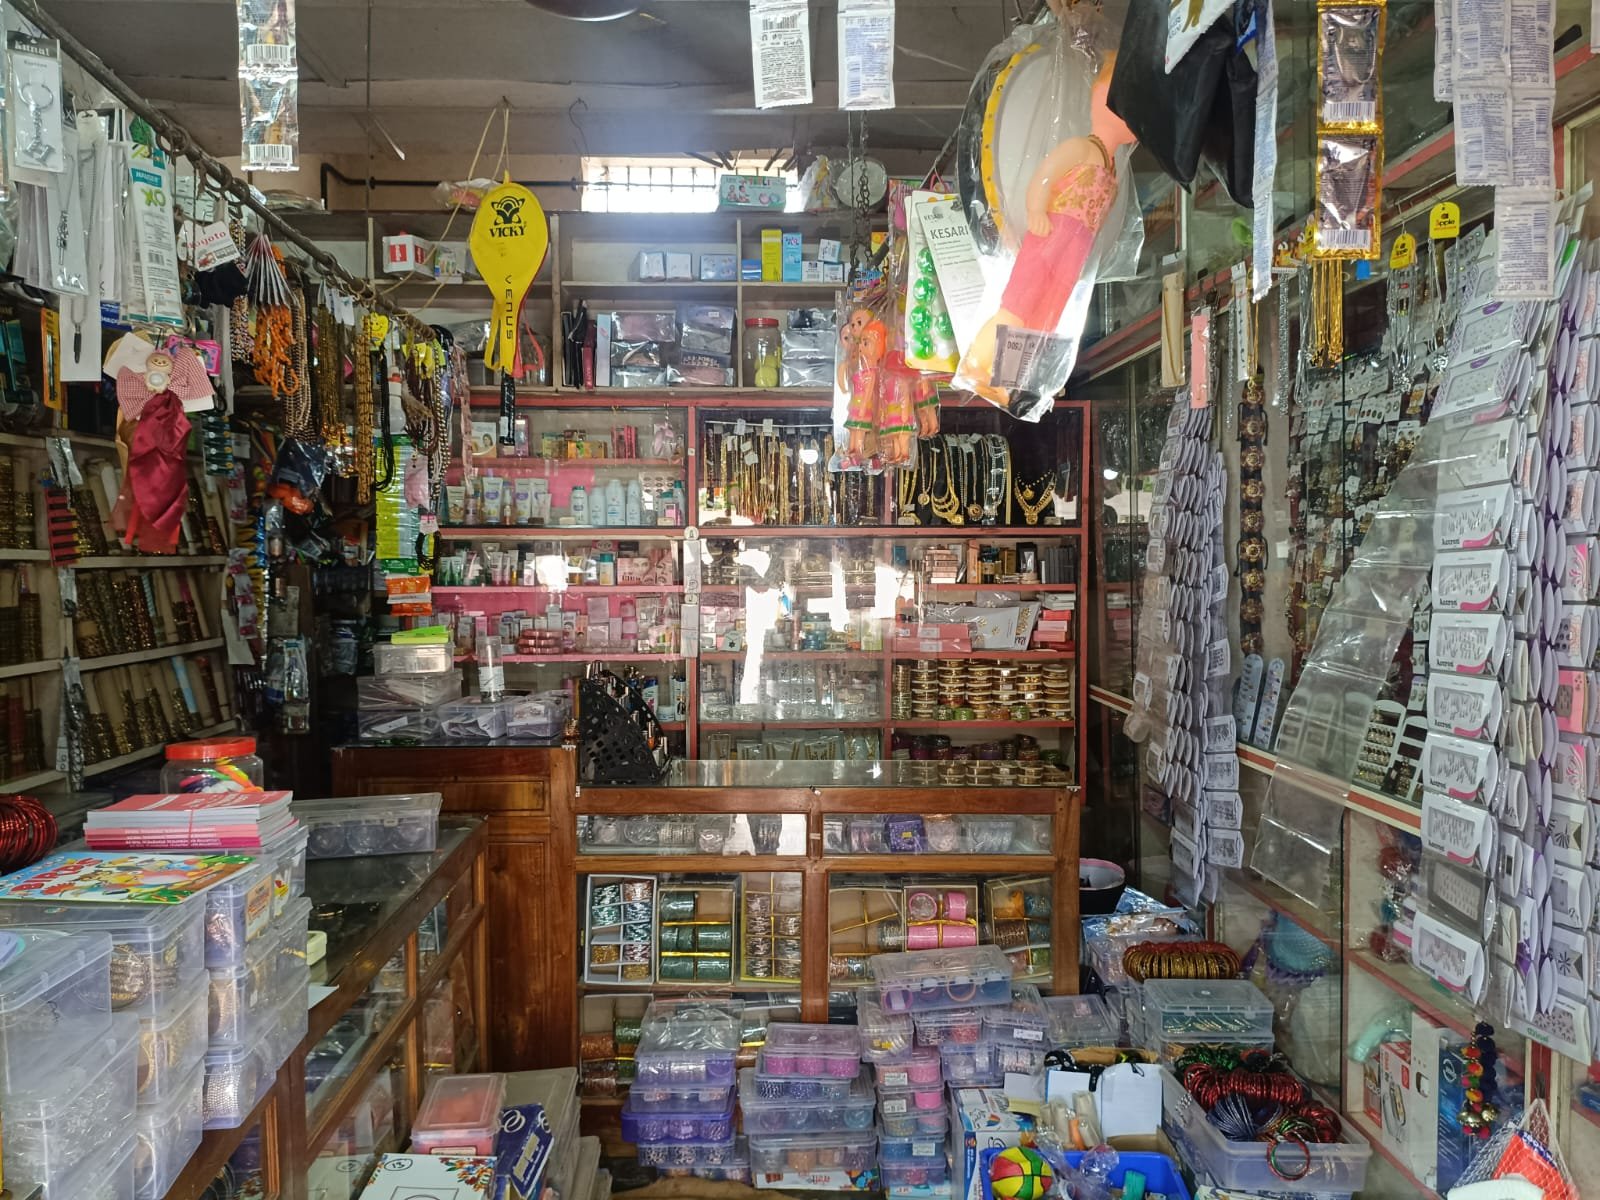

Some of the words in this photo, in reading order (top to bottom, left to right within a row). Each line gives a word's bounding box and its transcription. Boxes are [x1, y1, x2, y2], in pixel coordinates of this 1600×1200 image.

[489, 226, 527, 238] VICKY
[929, 225, 969, 240] KESARI
[504, 275, 514, 340] VENUS
